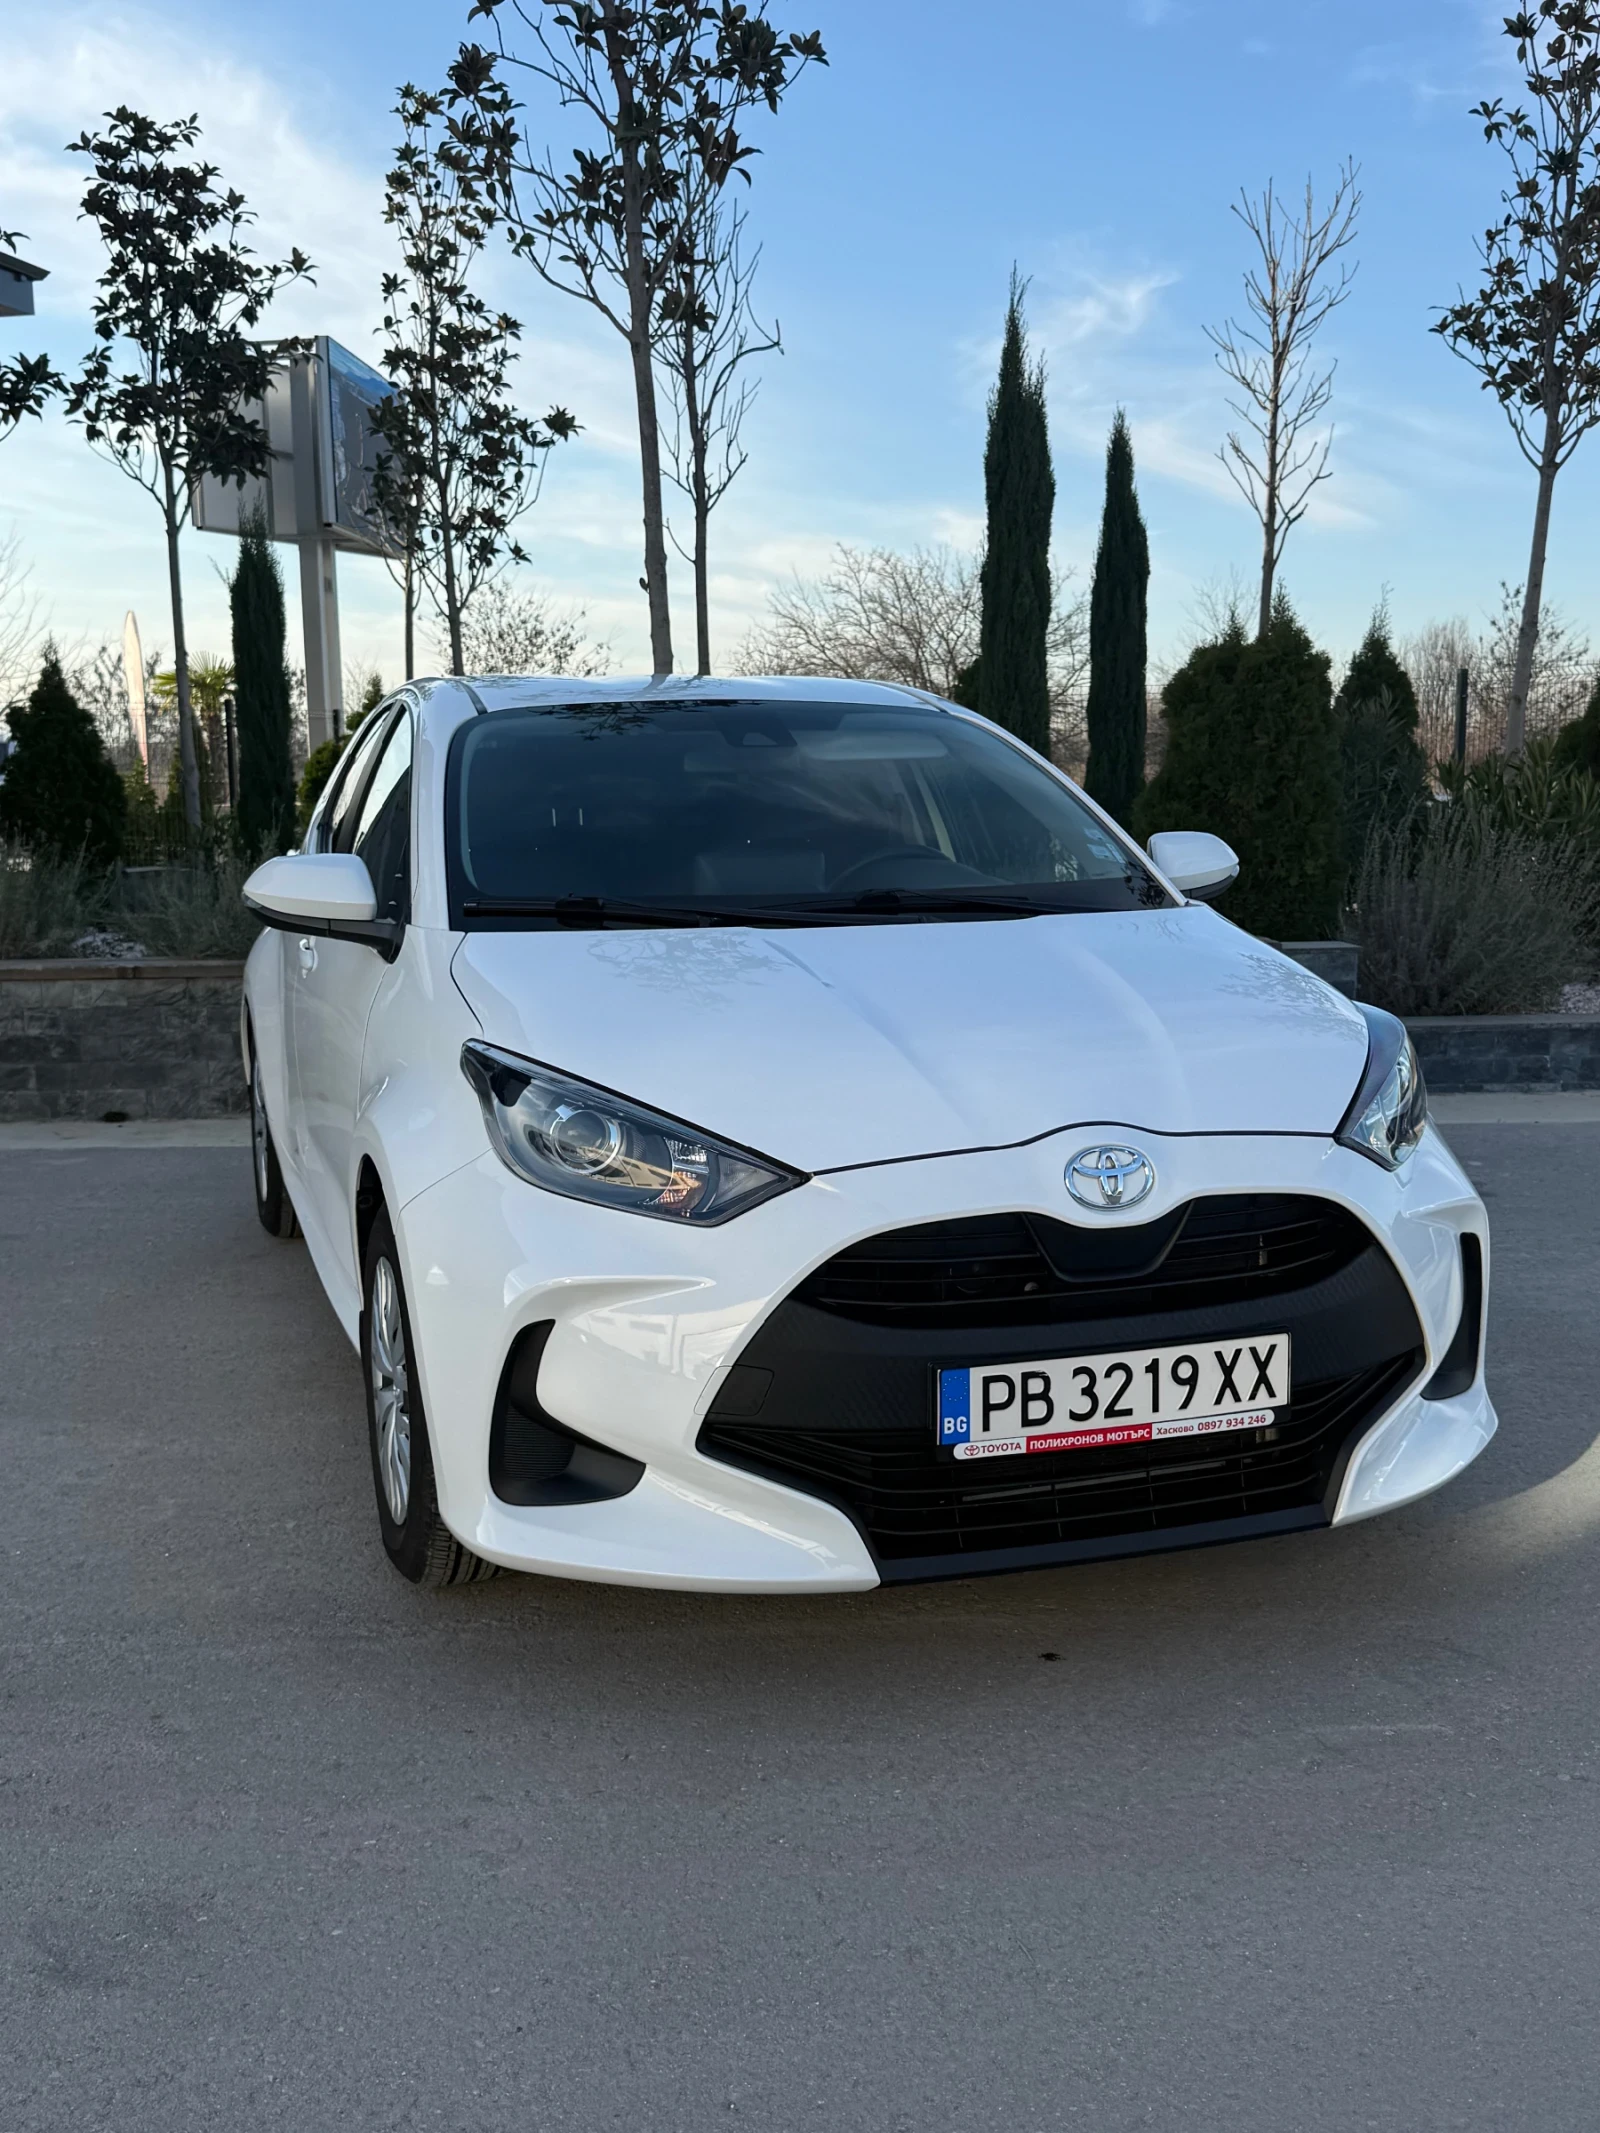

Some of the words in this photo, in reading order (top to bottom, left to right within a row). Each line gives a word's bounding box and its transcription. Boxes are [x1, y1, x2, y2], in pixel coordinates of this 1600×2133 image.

[982, 1371, 1054, 1432] PB
[1069, 1355, 1199, 1421] 3219
[1213, 1343, 1277, 1406] XX
[943, 1416, 968, 1435] BG
[1157, 1424, 1194, 1435] Хасково
[1198, 1420, 1223, 1431] 0897
[1226, 1417, 1245, 1427] 934
[1247, 1414, 1266, 1425] 246
[981, 1442, 1022, 1453] TOYOTA
[1029, 1434, 1104, 1450] ПОЛИХРОНОВ
[1107, 1428, 1150, 1441] МОТЪРС
